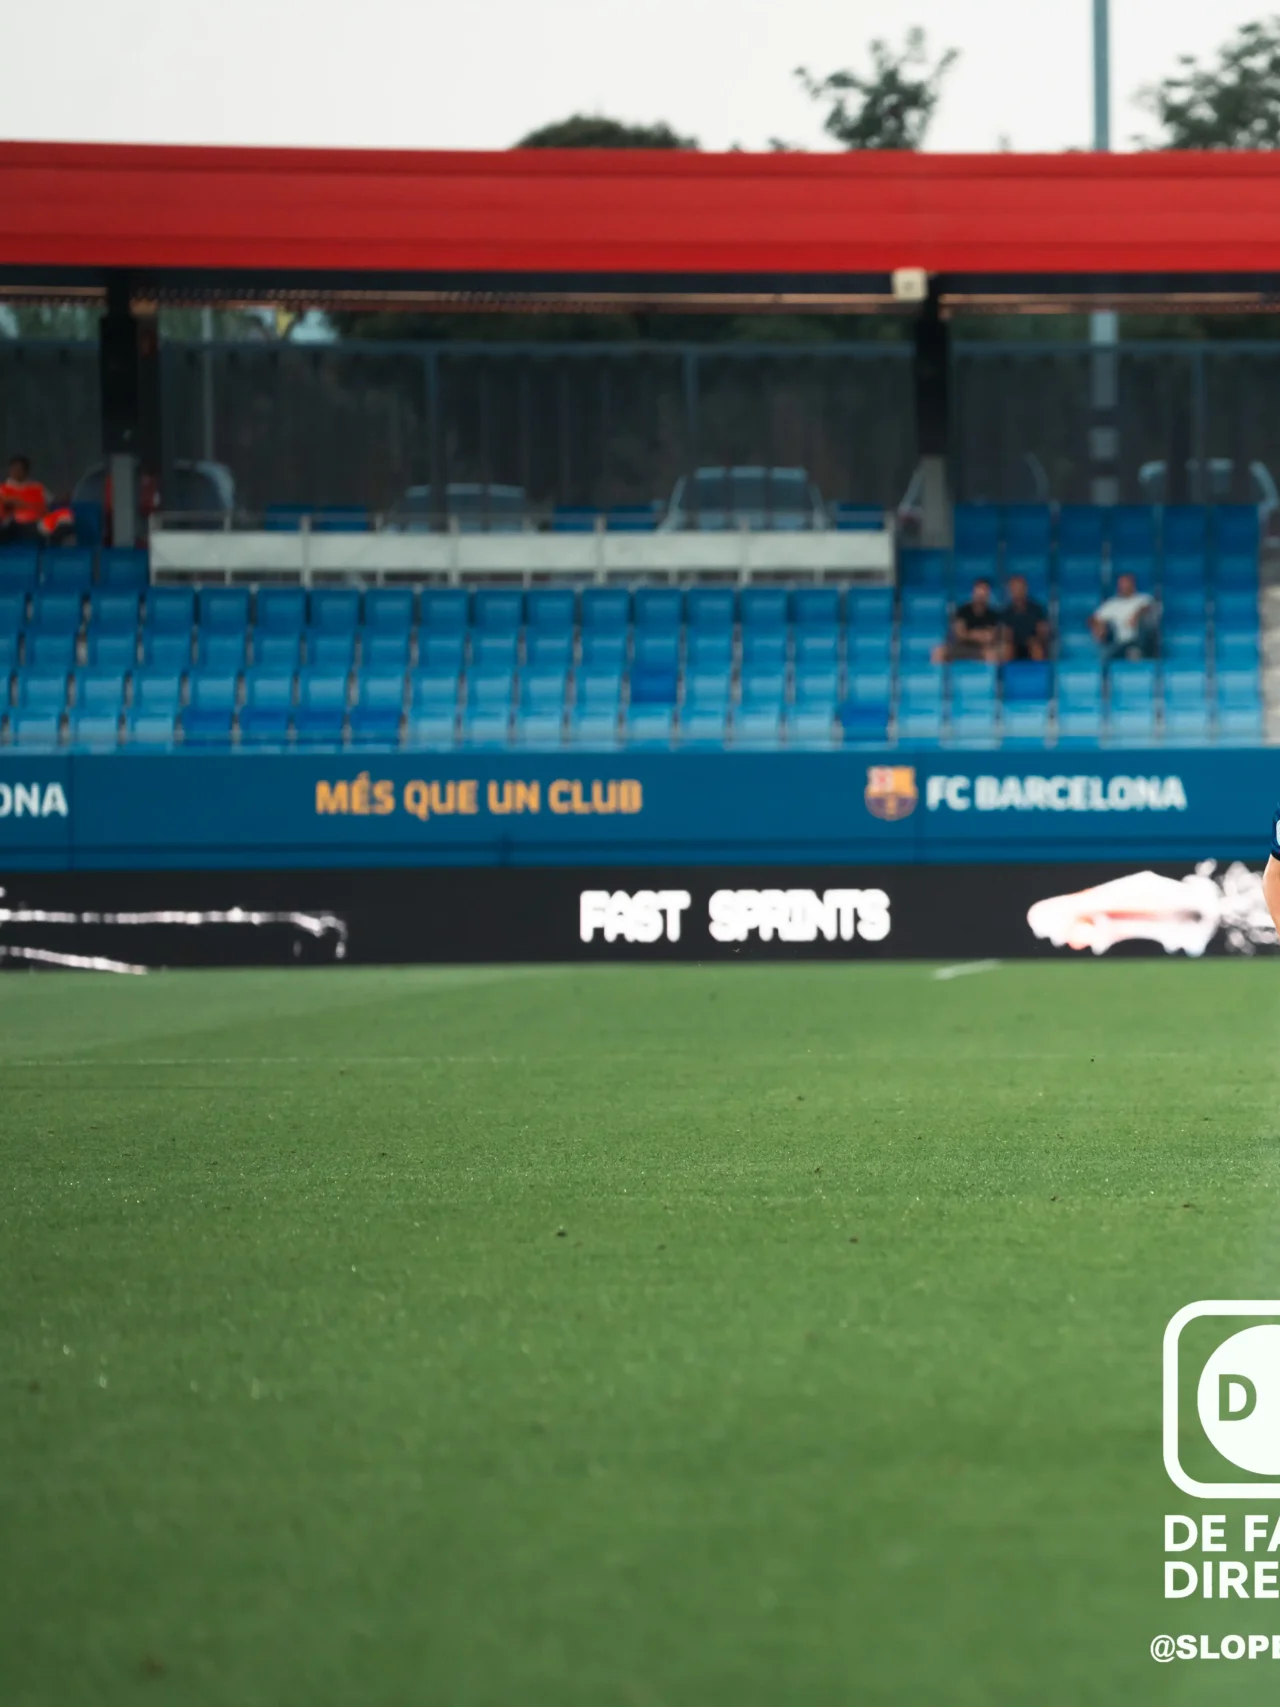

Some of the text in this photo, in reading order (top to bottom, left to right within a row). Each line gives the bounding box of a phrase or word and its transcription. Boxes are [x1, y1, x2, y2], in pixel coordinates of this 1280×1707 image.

[315, 771, 643, 821] MÉS QUE UN CLUB
[926, 775, 1188, 811] FC BARCELONA
[579, 888, 891, 943] FAST SPRINTS
